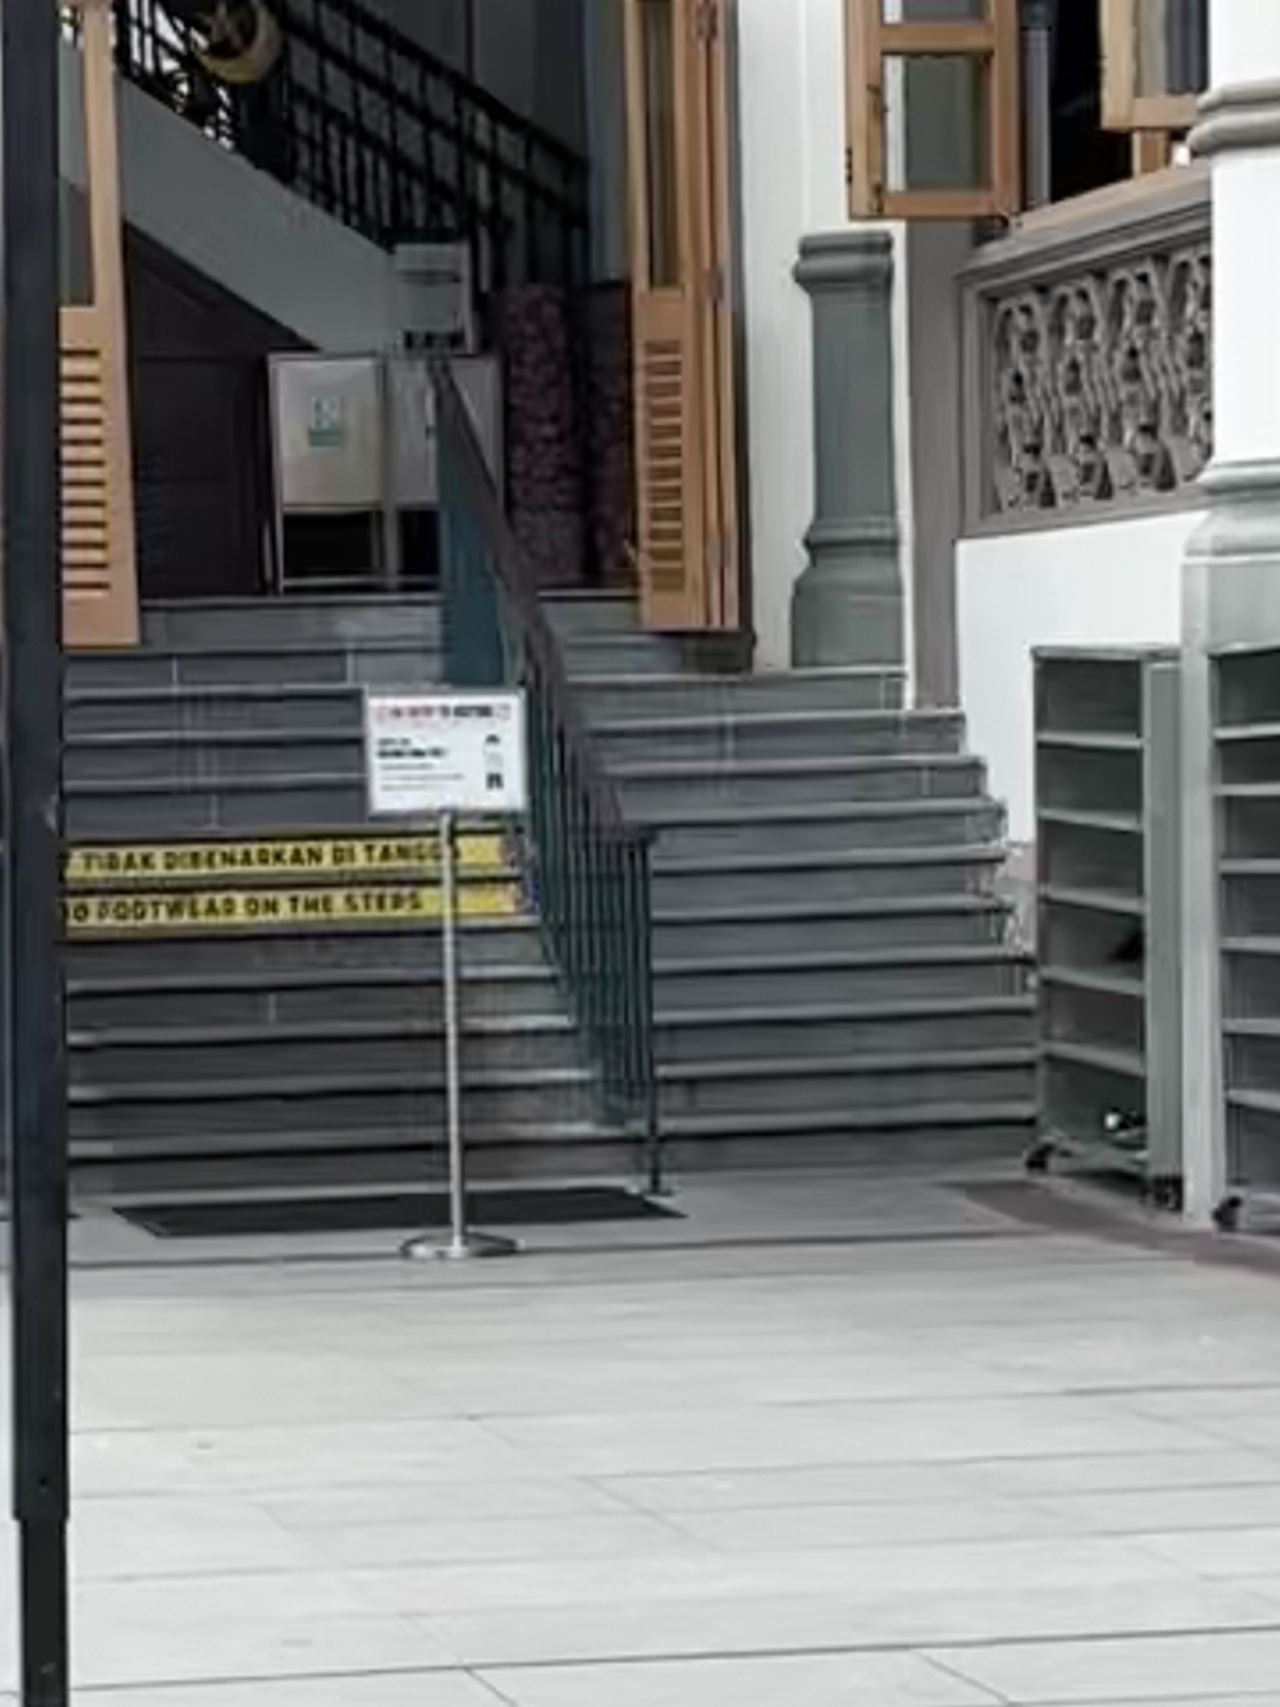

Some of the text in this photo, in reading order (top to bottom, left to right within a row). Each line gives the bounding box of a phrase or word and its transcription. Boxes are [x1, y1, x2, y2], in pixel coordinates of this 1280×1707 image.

[82, 850, 156, 870] TIDAK
[98, 895, 238, 921] FOOTWEAR
[245, 895, 279, 914] ON
[289, 893, 334, 913] THE
[344, 890, 423, 912] STEPS
